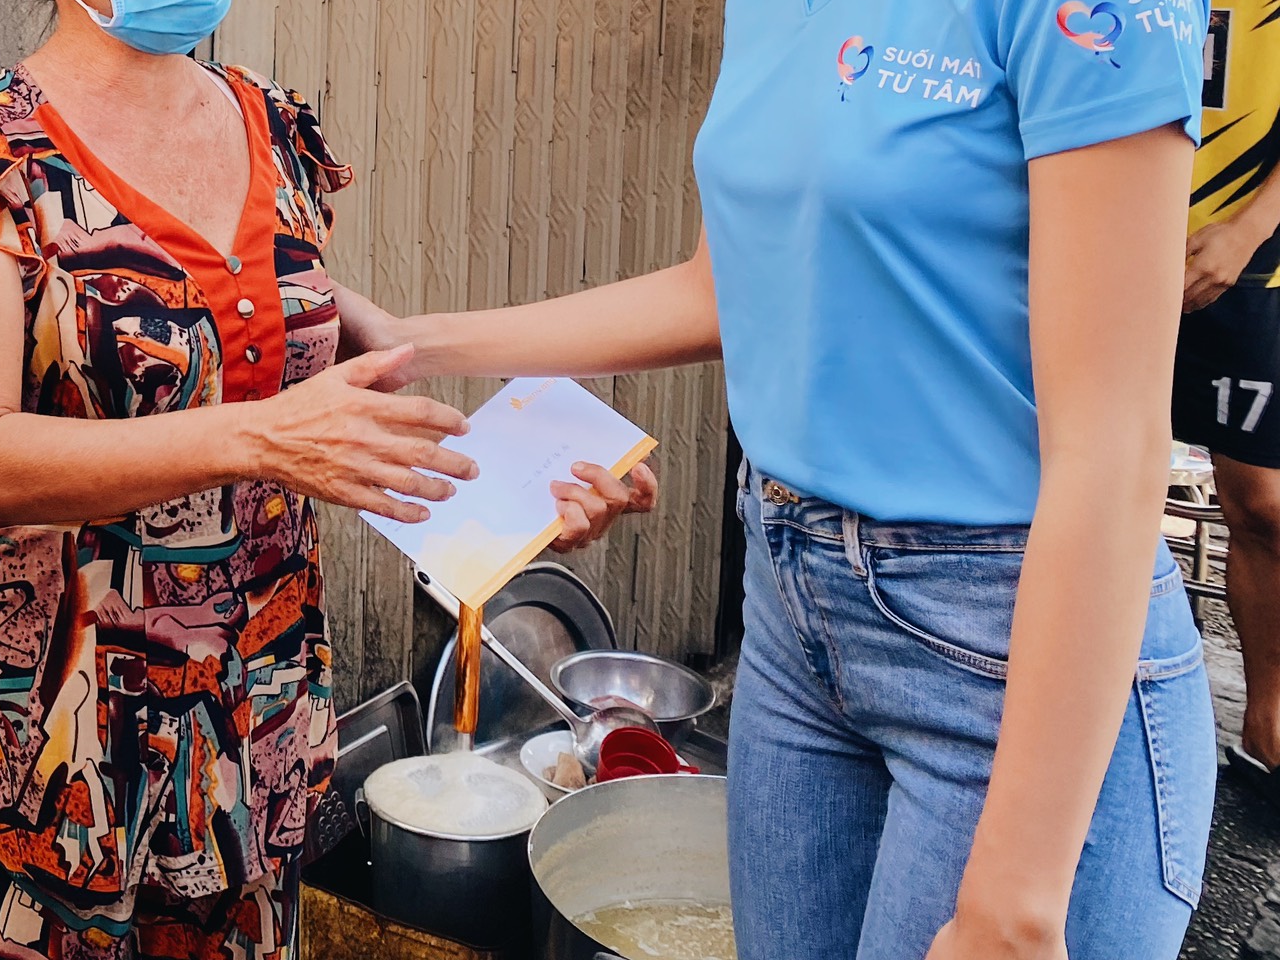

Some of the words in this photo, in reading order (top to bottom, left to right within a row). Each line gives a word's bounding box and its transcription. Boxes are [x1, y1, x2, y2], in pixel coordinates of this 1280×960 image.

[882, 46, 935, 70] SUỐI
[878, 68, 917, 94] TỪ
[922, 78, 982, 109] TÂM
[1211, 376, 1273, 433] 17
